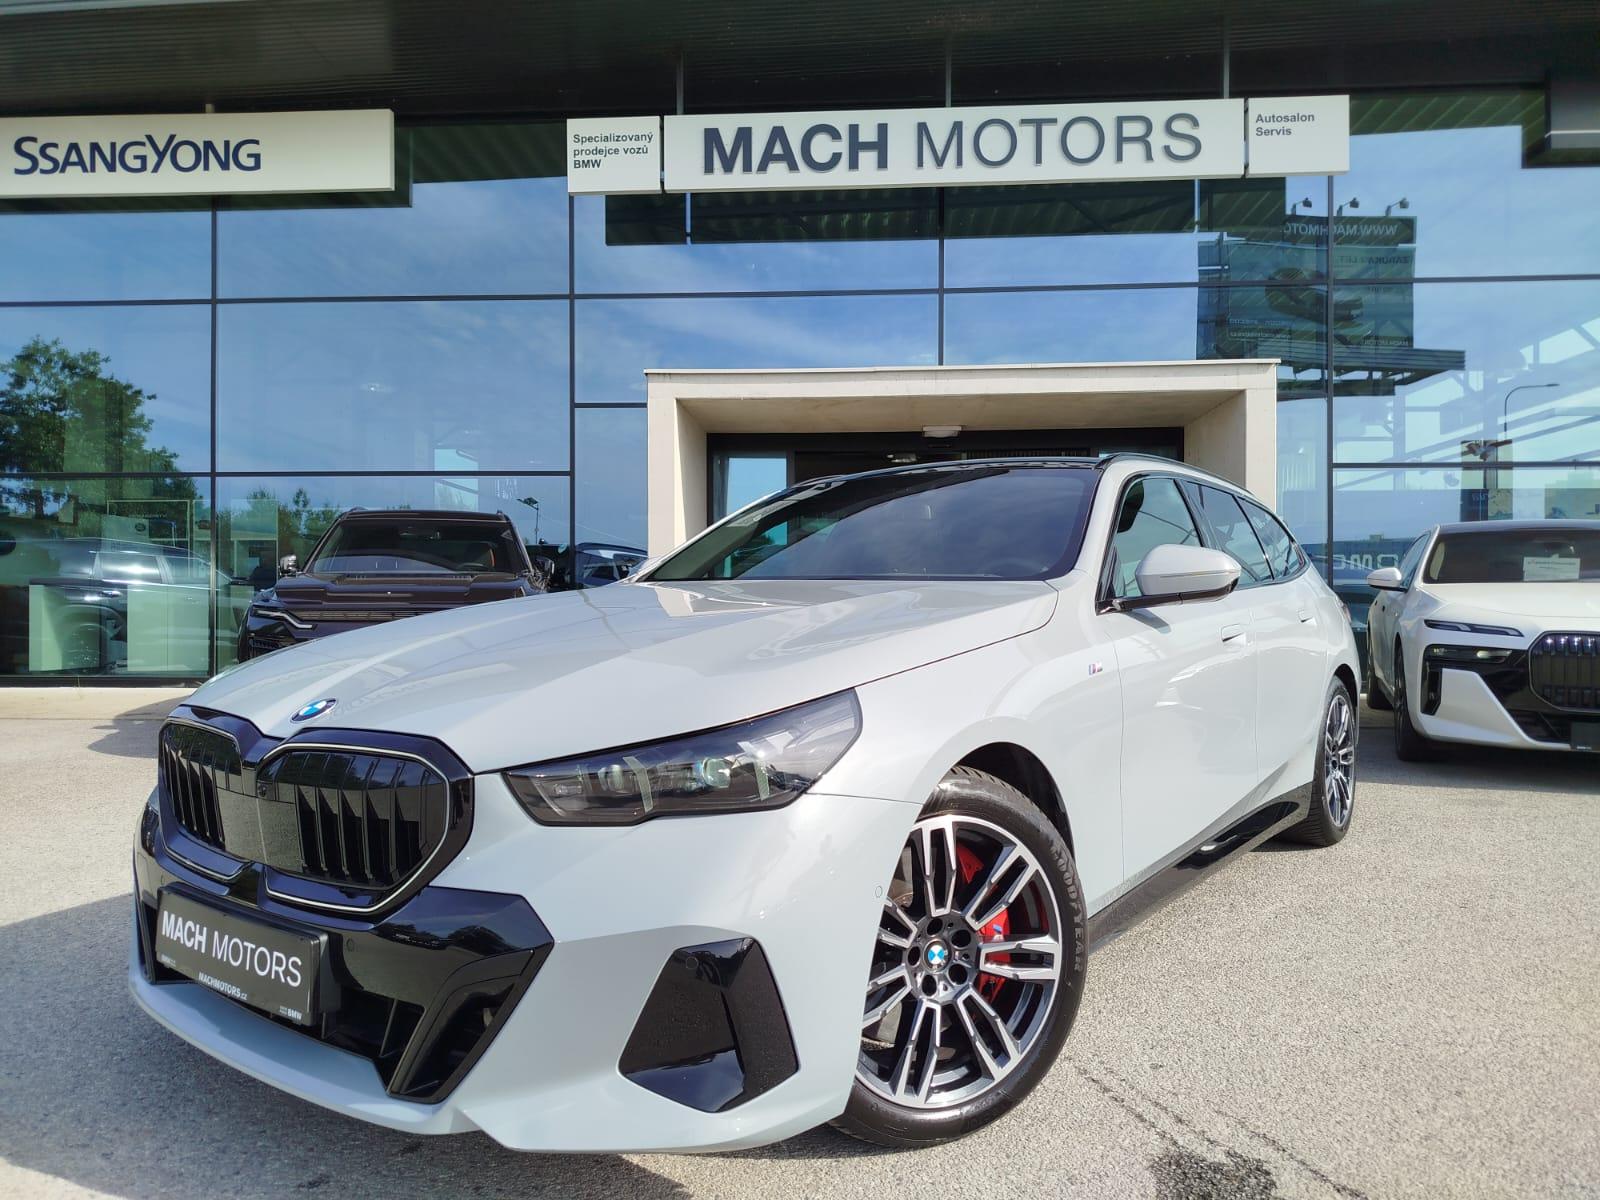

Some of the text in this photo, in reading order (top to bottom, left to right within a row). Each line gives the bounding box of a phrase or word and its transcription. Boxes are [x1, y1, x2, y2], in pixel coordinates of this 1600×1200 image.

[1255, 112, 1315, 124] Autosalon
[1255, 126, 1293, 137] Servis
[573, 132, 654, 145] Specializovaný
[703, 112, 1203, 175] MACH MOTORS
[573, 144, 649, 159] prodejce vozů
[573, 159, 602, 169] BMW
[161, 911, 302, 987] MACH MOTORS
